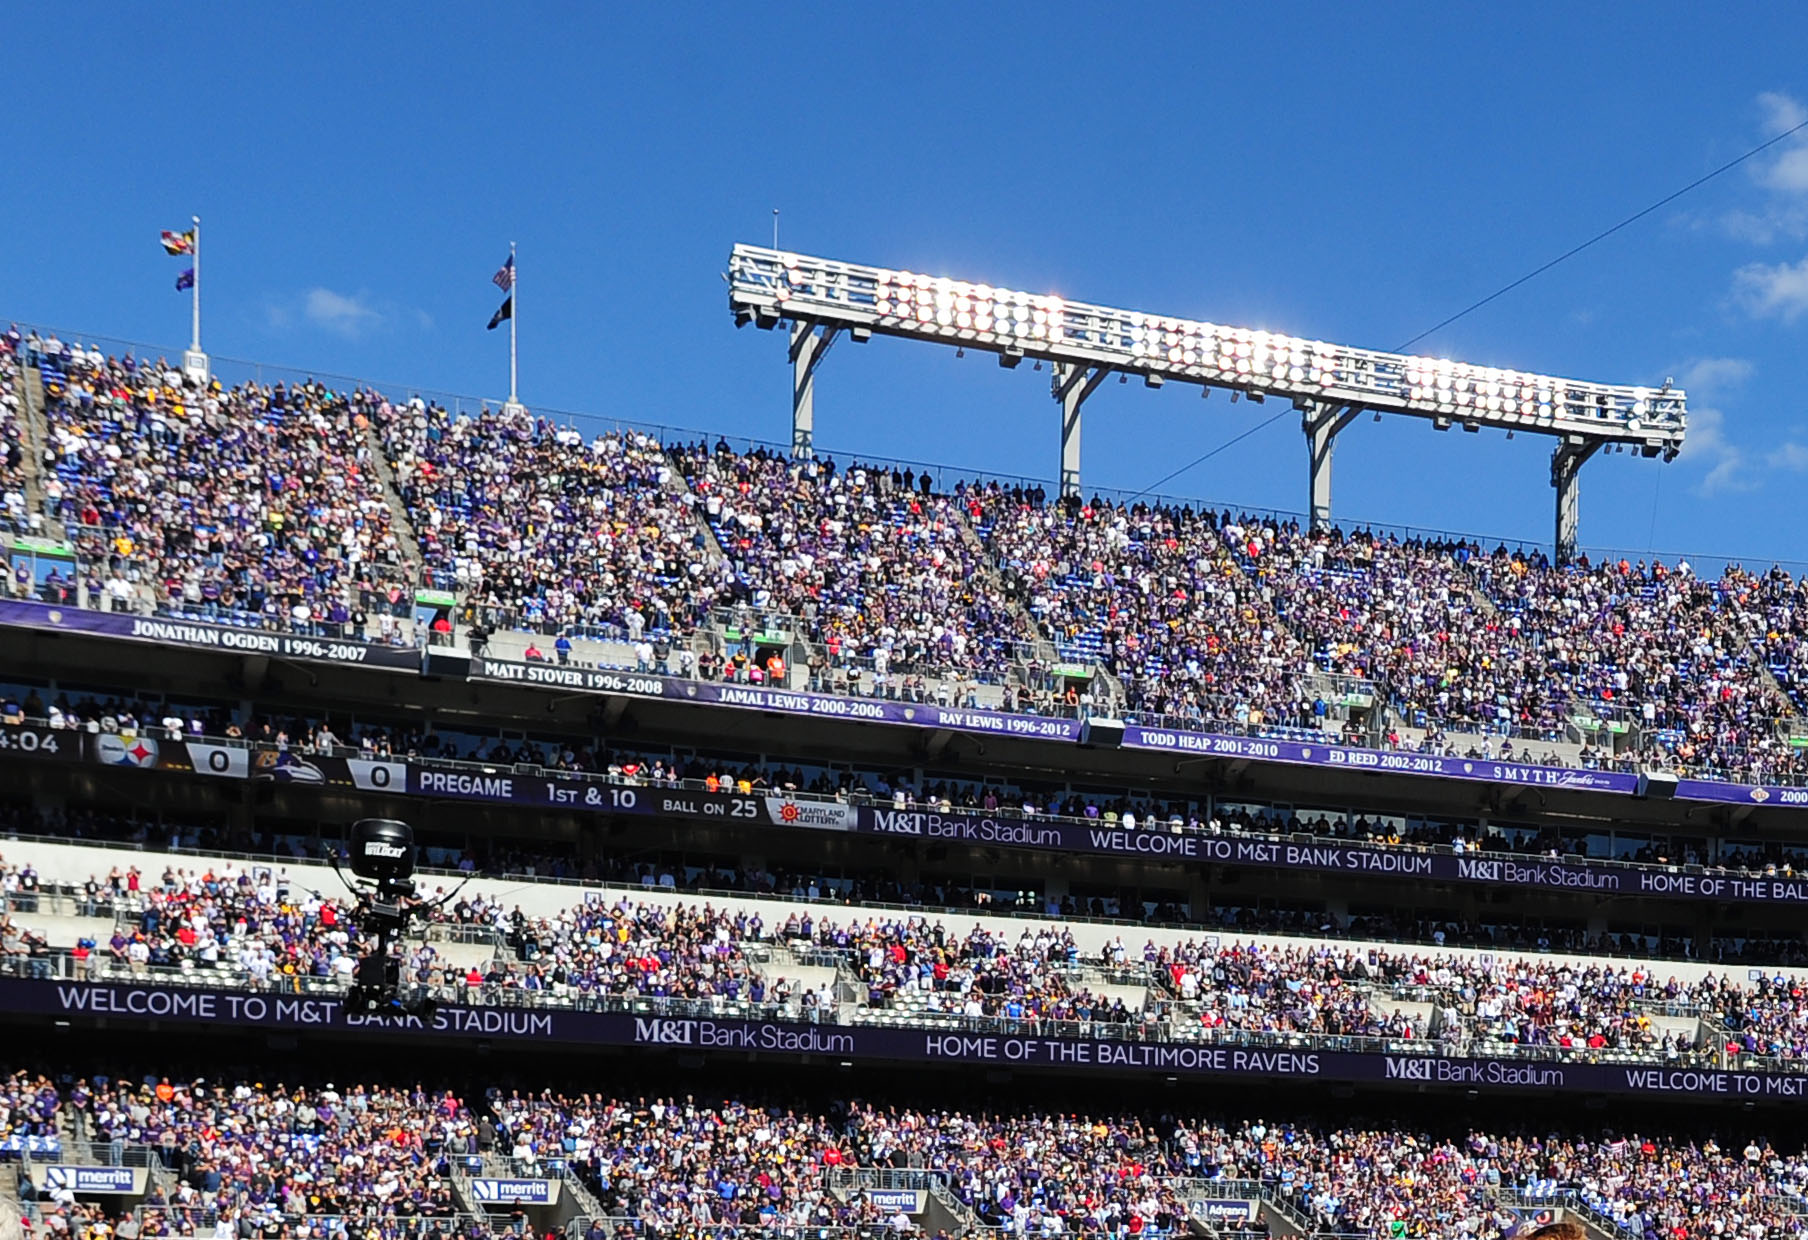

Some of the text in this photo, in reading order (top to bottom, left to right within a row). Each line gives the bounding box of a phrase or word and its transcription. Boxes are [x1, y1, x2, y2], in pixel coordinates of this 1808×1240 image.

[131, 620, 366, 661] JONATHAN OGDEN 1996-2007
[485, 662, 662, 694] MATT STOVER 1996-2008
[718, 689, 884, 718] JAMAL LEWIS 2000-2006
[939, 712, 1070, 737] RAY LEWIS 1996-2012
[1140, 732, 1278, 757] TODD HEAP 2001-2010
[209, 750, 230, 773] 0
[1329, 750, 1443, 772] ED REED 2002-2012
[370, 766, 390, 787] 0
[1494, 767, 1557, 783] SMYTH
[420, 771, 636, 808] PREGAME 1ST & 10
[1781, 791, 1808, 803] 2000
[663, 800, 757, 818] BALL ON 25
[800, 807, 845, 818] MARYLAND
[873, 810, 1061, 846] M&T Bank Stadium
[1089, 830, 1432, 874] WELCOME TO M&T BANK STADIUM
[1457, 858, 1619, 889] M&T Bank Stadium
[1641, 874, 1695, 894] HOME
[1700, 878, 1725, 896] OF
[1730, 881, 1766, 898] THE
[58, 986, 217, 1018] WELCOME
[226, 995, 267, 1021] TO
[276, 1001, 337, 1024] M&T
[431, 1007, 552, 1036] STADIUM
[634, 1018, 854, 1053] M&T Bank Stadium
[926, 1036, 1320, 1075] HOME OF THE BALTIMORE RAVENS
[1385, 1057, 1564, 1087] M&T Bank Stadium
[1625, 1069, 1728, 1093] WELCOME
[1734, 1074, 1761, 1094] TO
[1767, 1076, 1806, 1096] M&T
[78, 1171, 131, 1184] merritt
[500, 1182, 547, 1195] merritt
[873, 1192, 915, 1205] merritt
[1209, 1204, 1248, 1216] Advance
